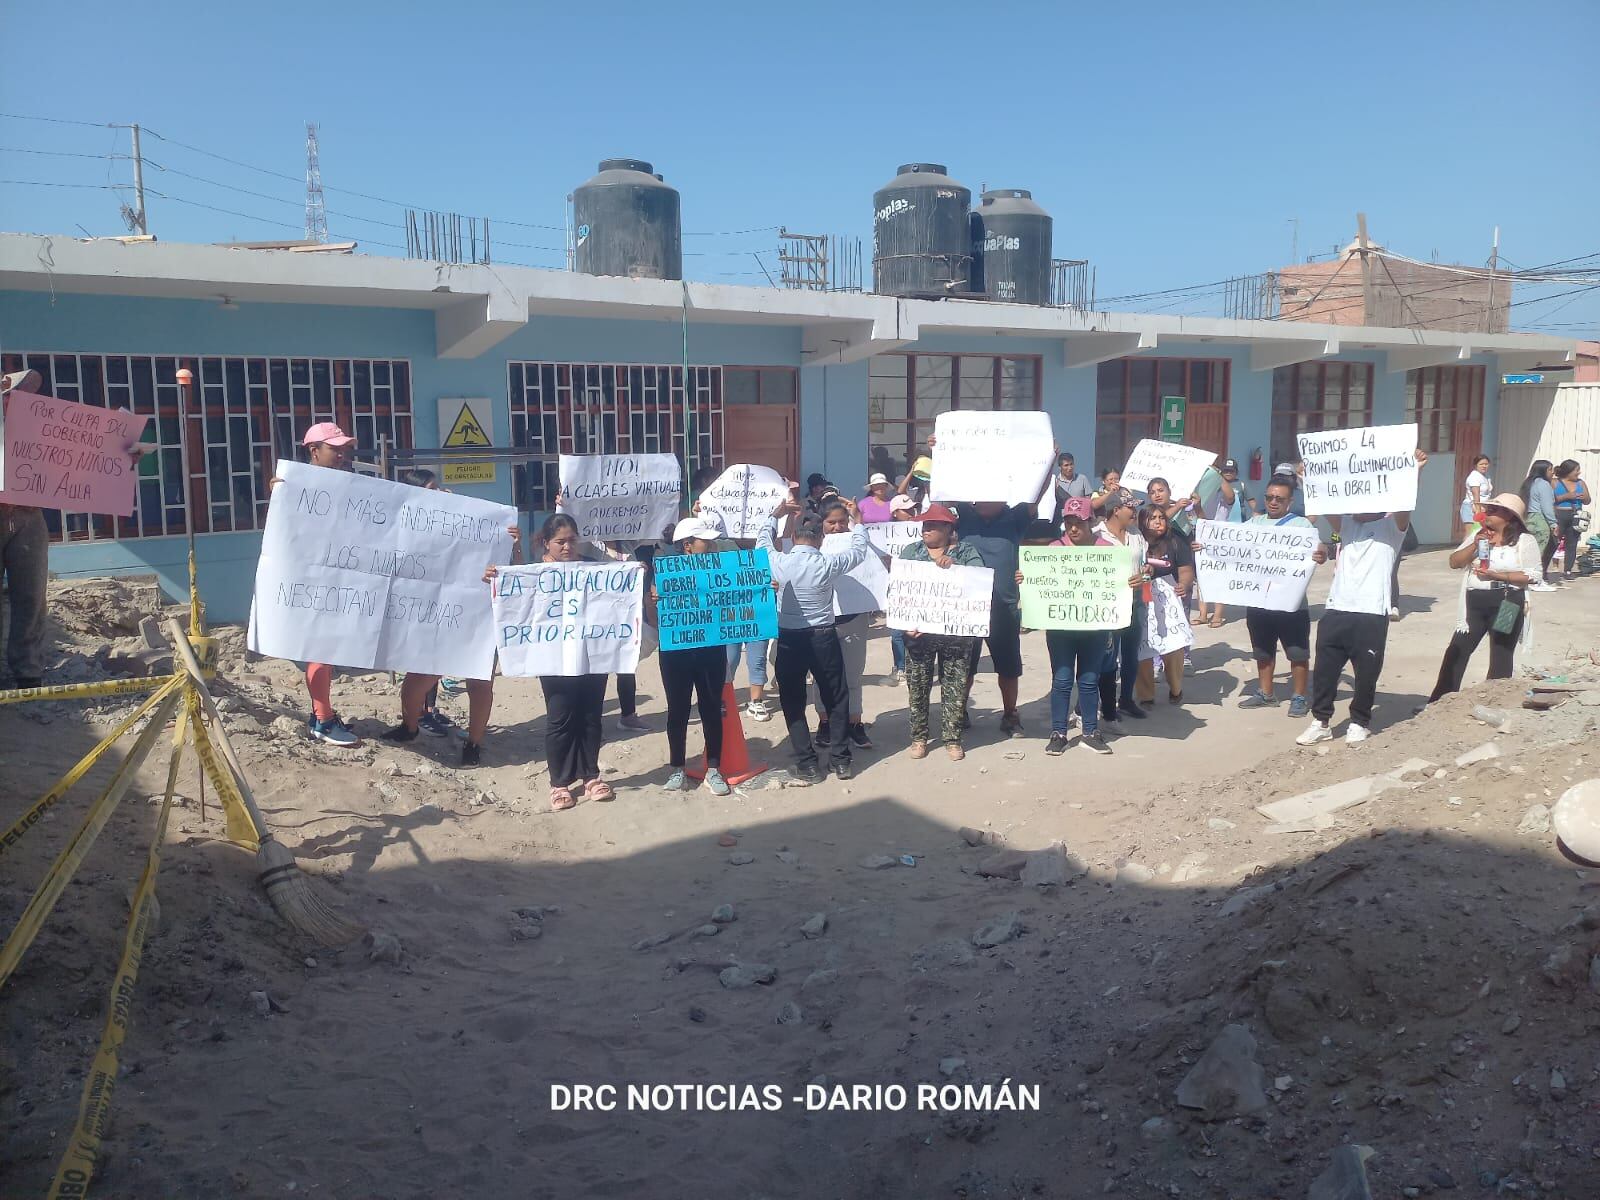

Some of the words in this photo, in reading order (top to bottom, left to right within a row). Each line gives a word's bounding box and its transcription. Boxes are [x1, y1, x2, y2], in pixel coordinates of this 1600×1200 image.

[30, 400, 55, 419] POR
[61, 404, 100, 431] CULPA
[41, 423, 104, 449] GOBIERNO
[1300, 437, 1348, 456] PEDIMOS
[1361, 429, 1375, 449] LA
[11, 440, 73, 467] NUESTROS
[75, 450, 123, 477] NIÑOS
[1303, 457, 1338, 477] PRONTA
[1348, 452, 1415, 474] CULMINACIÓN
[562, 485, 570, 499] A
[574, 482, 629, 499] CLASES
[1306, 484, 1318, 499] DE
[1328, 480, 1339, 497] LA
[298, 487, 331, 516] NO
[344, 493, 387, 525] MÁS
[400, 504, 500, 544] INDIFERENCIA
[589, 504, 648, 519] QUEREMOS
[320, 543, 360, 570] LOS
[370, 548, 426, 580] NIÑOS
[738, 550, 755, 568] LA
[1199, 543, 1262, 560] PERSONAS
[539, 566, 638, 593] EDUCACIÓN
[1200, 560, 1227, 571] PARA
[1235, 561, 1286, 577] TERMINAR
[1292, 569, 1306, 578] LA
[707, 572, 732, 589] LOS
[276, 582, 377, 617] NESECITAN
[385, 592, 463, 629] ESTUDIAR
[706, 589, 753, 607] DERECHO
[761, 587, 768, 603] A
[547, 599, 578, 618] ES
[660, 610, 713, 627] ESTUDIAR
[721, 607, 735, 622] EN
[740, 605, 754, 621] UN
[672, 629, 706, 644] LUGAR
